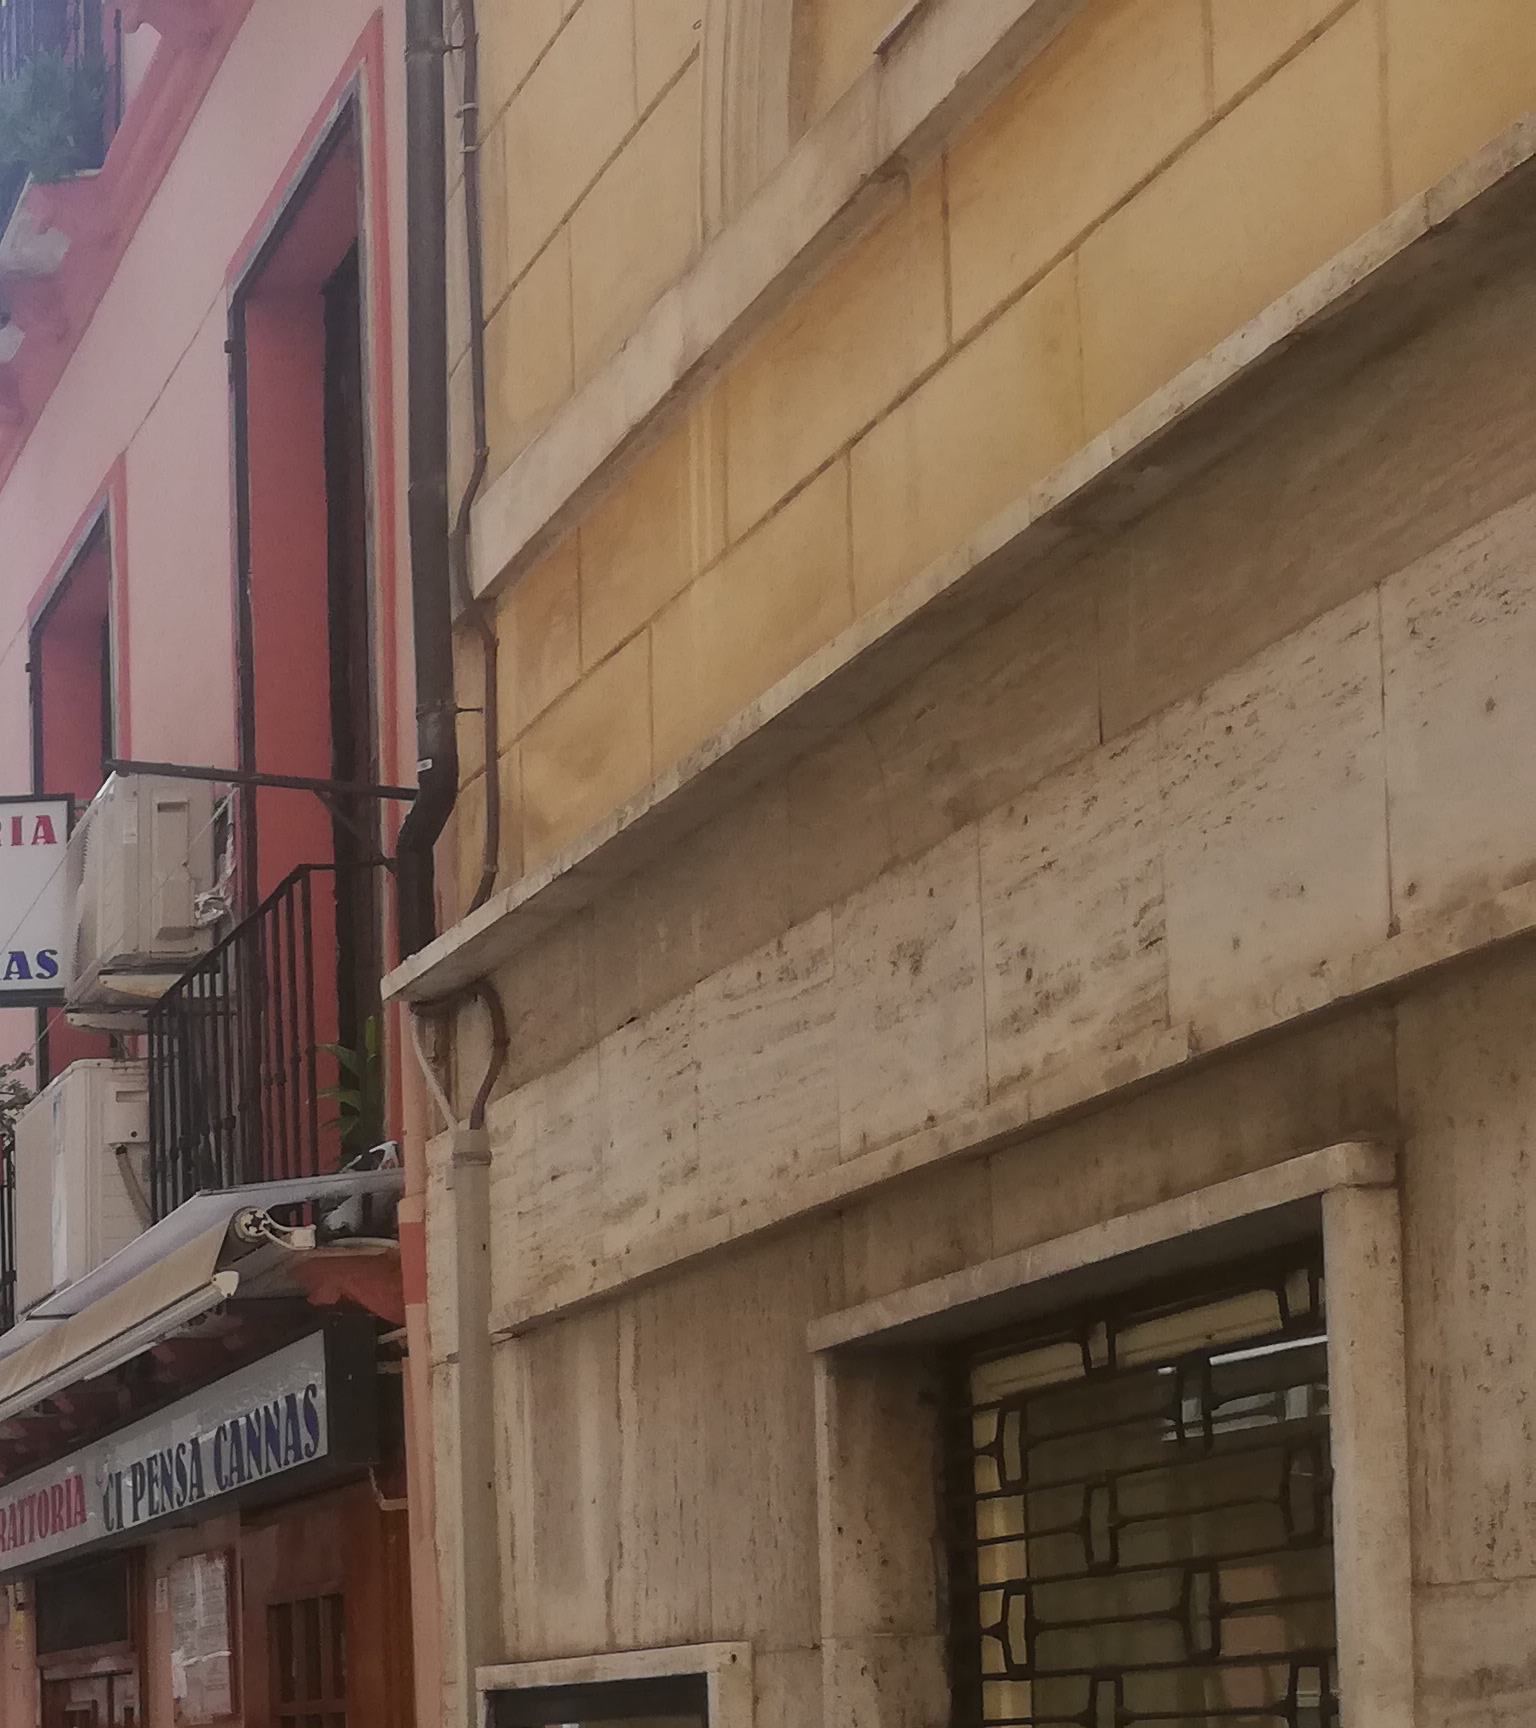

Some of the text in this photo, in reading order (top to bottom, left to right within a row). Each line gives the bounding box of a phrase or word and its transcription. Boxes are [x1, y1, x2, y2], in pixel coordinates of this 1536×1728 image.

[102, 1471, 125, 1532] CI
[131, 1437, 206, 1522] PENSA
[214, 1383, 320, 1491] CANNAS
